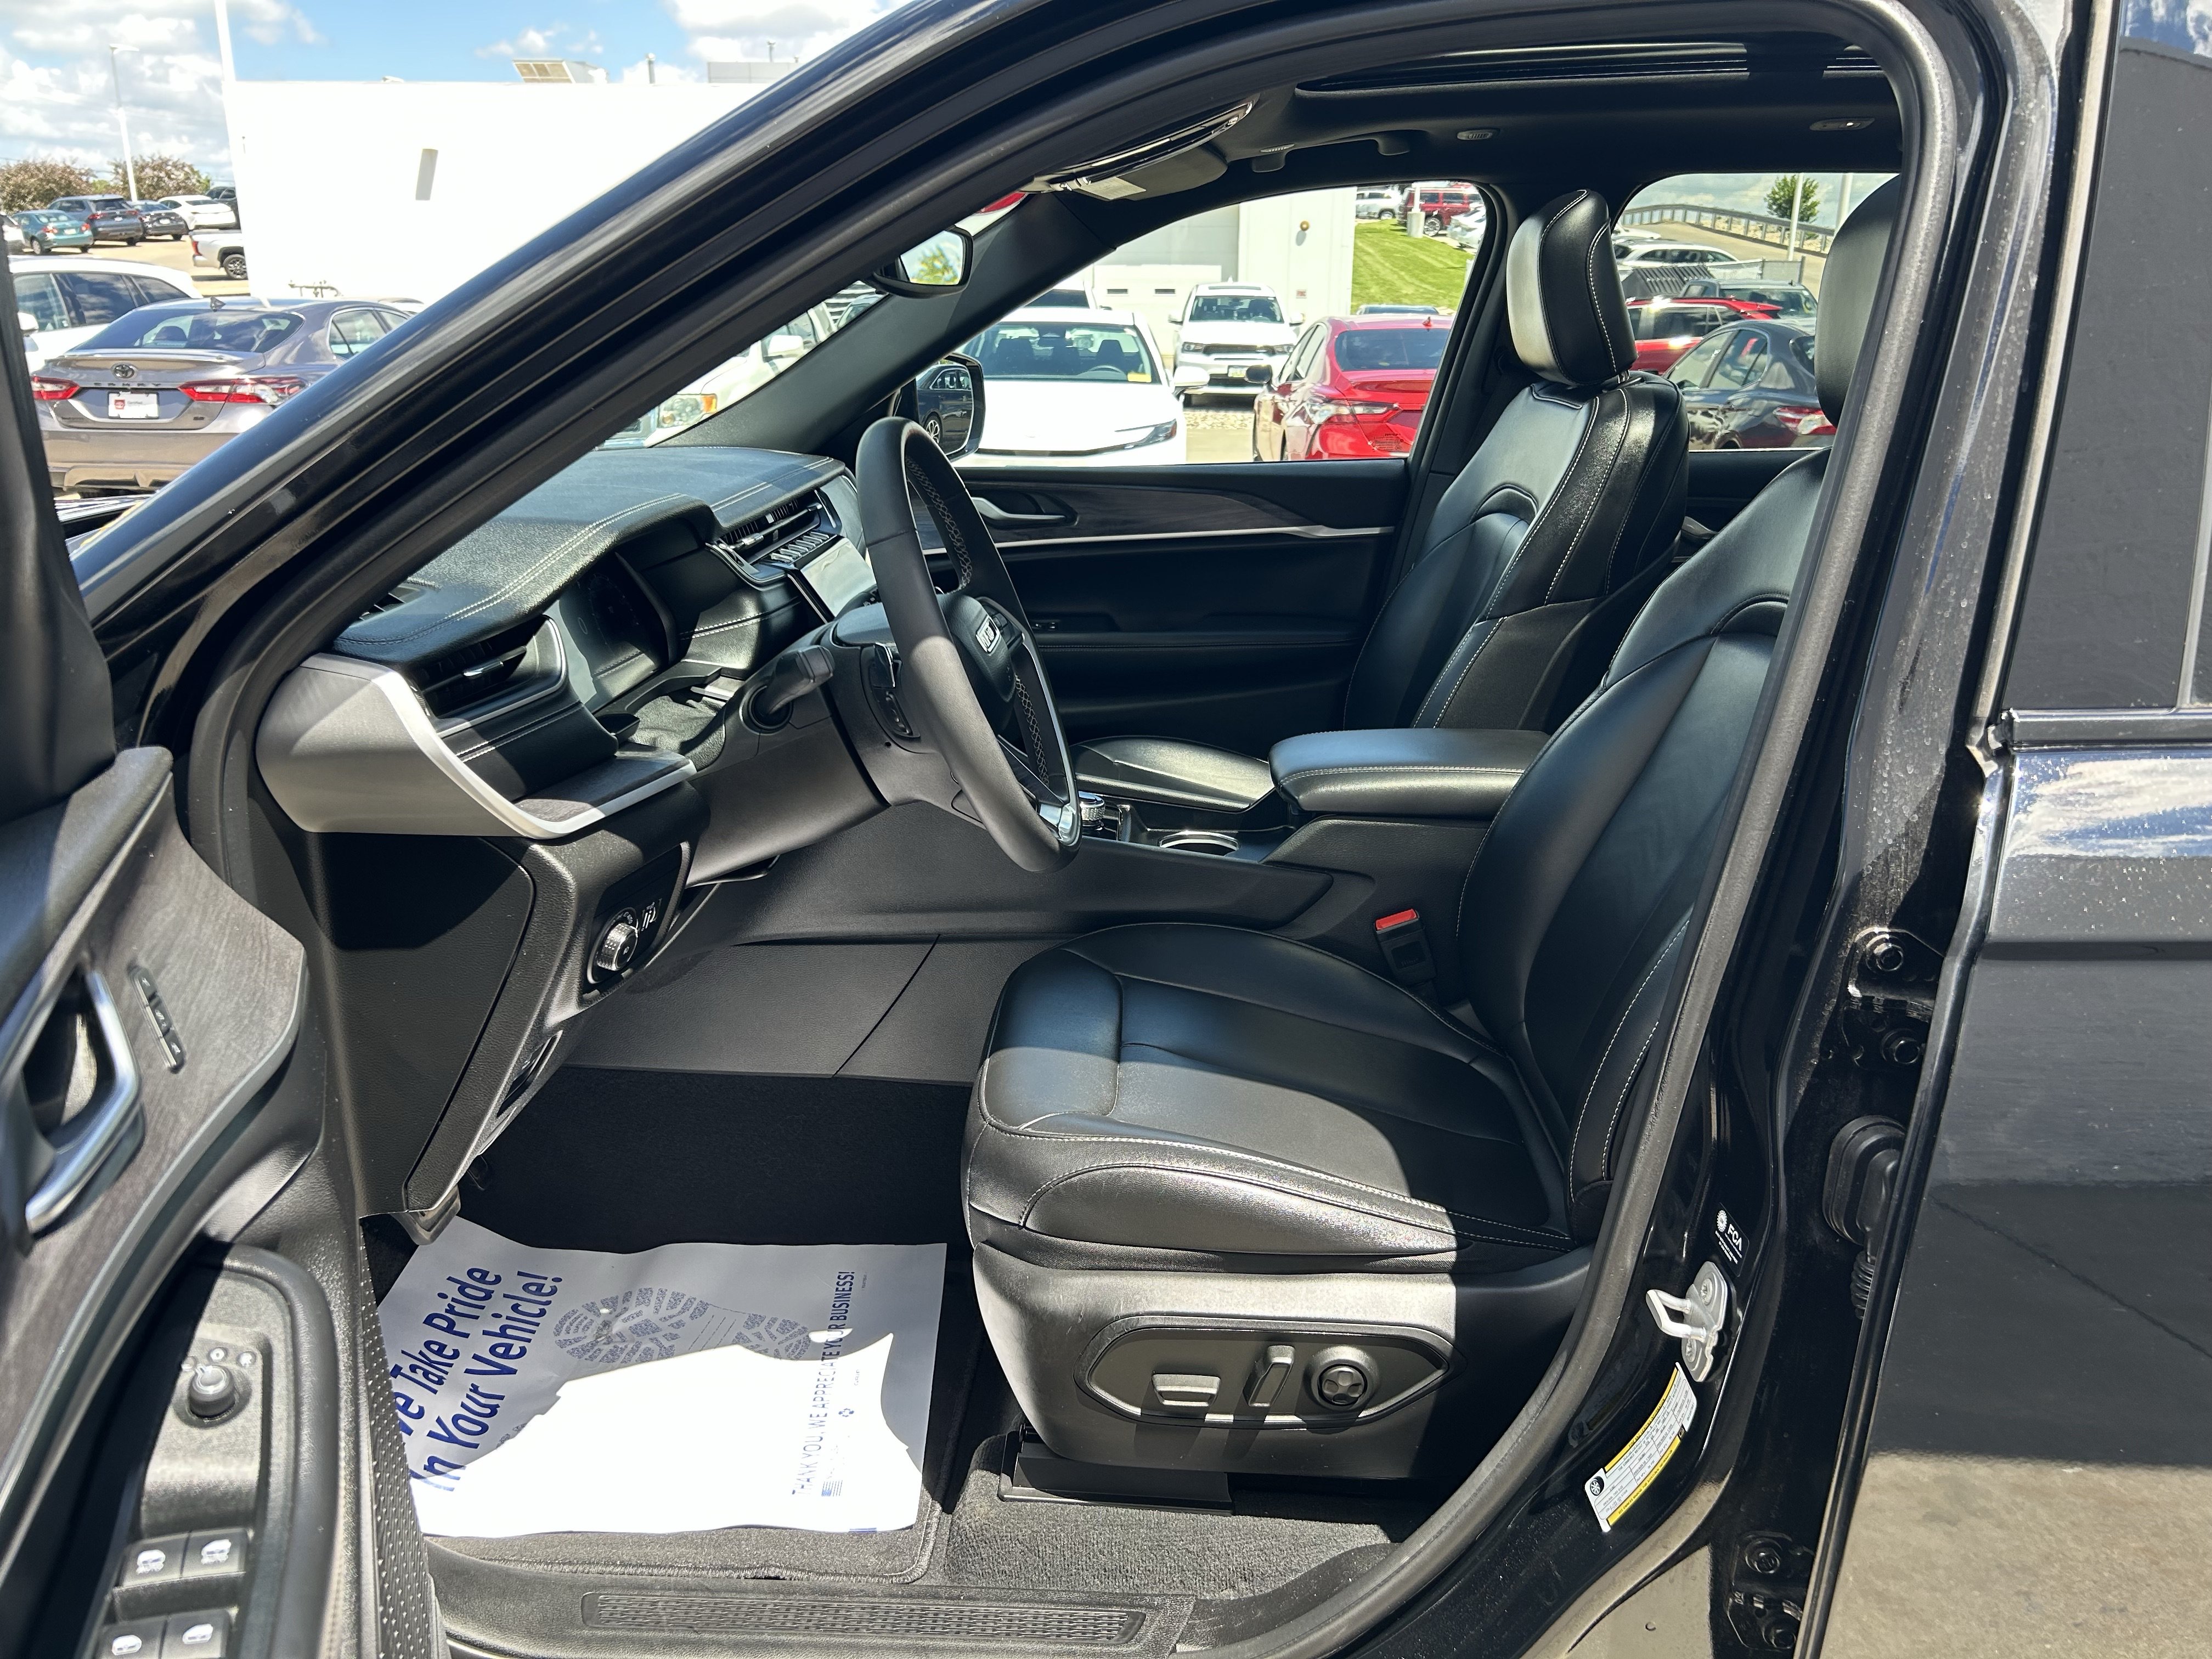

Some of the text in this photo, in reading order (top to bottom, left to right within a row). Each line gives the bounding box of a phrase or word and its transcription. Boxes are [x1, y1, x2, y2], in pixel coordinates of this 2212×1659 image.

[422, 1267, 502, 1339] Pride
[464, 1270, 562, 1375] Vehicle!
[830, 1271, 855, 1321] BUSINESS!
[823, 1323, 847, 1347] YOUR
[390, 1339, 460, 1395] Take
[812, 1351, 840, 1409] APPRECIATE
[426, 1383, 505, 1449] Your
[808, 1413, 827, 1429] WE
[792, 1462, 818, 1495] THANK
